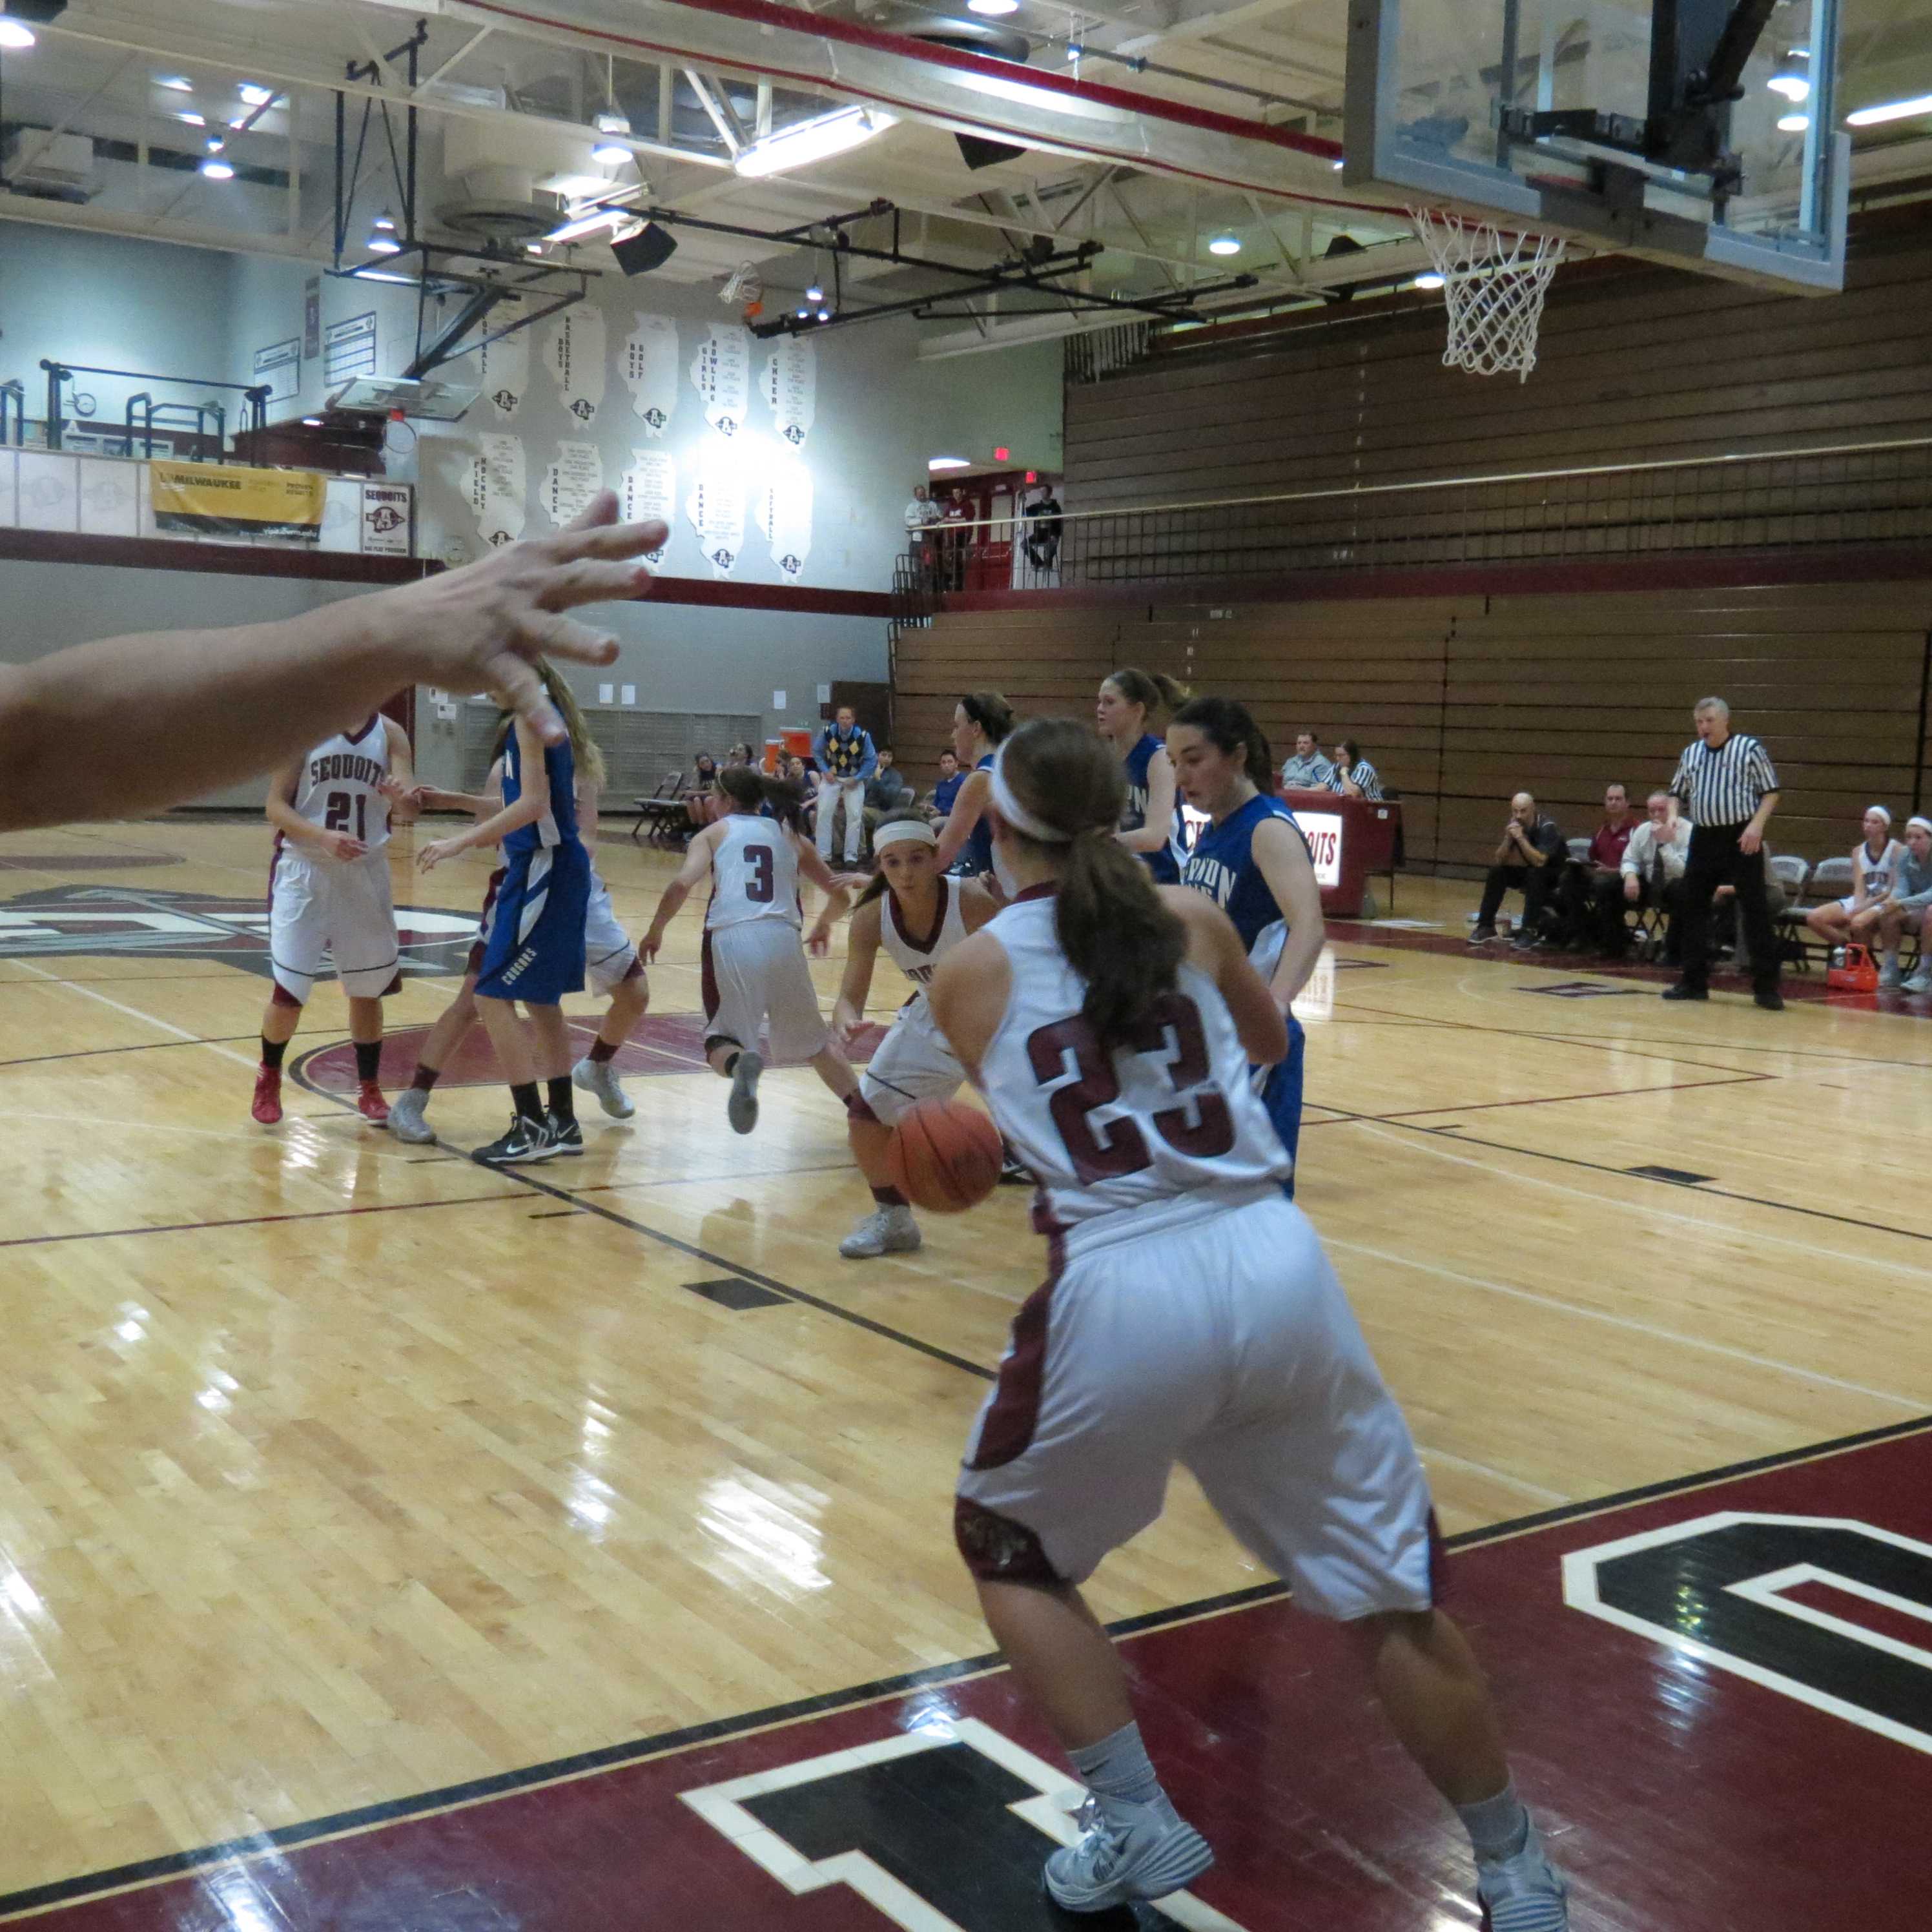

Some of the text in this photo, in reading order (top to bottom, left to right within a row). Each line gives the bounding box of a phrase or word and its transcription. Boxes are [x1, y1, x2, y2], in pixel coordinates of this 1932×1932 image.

[365, 489, 407, 502] SEQUOITS
[325, 792, 366, 841] 21
[743, 844, 774, 903] 3
[1186, 857, 1237, 910] RNON
[501, 947, 537, 985] COUGARS
[1027, 993, 1236, 1186] 23
